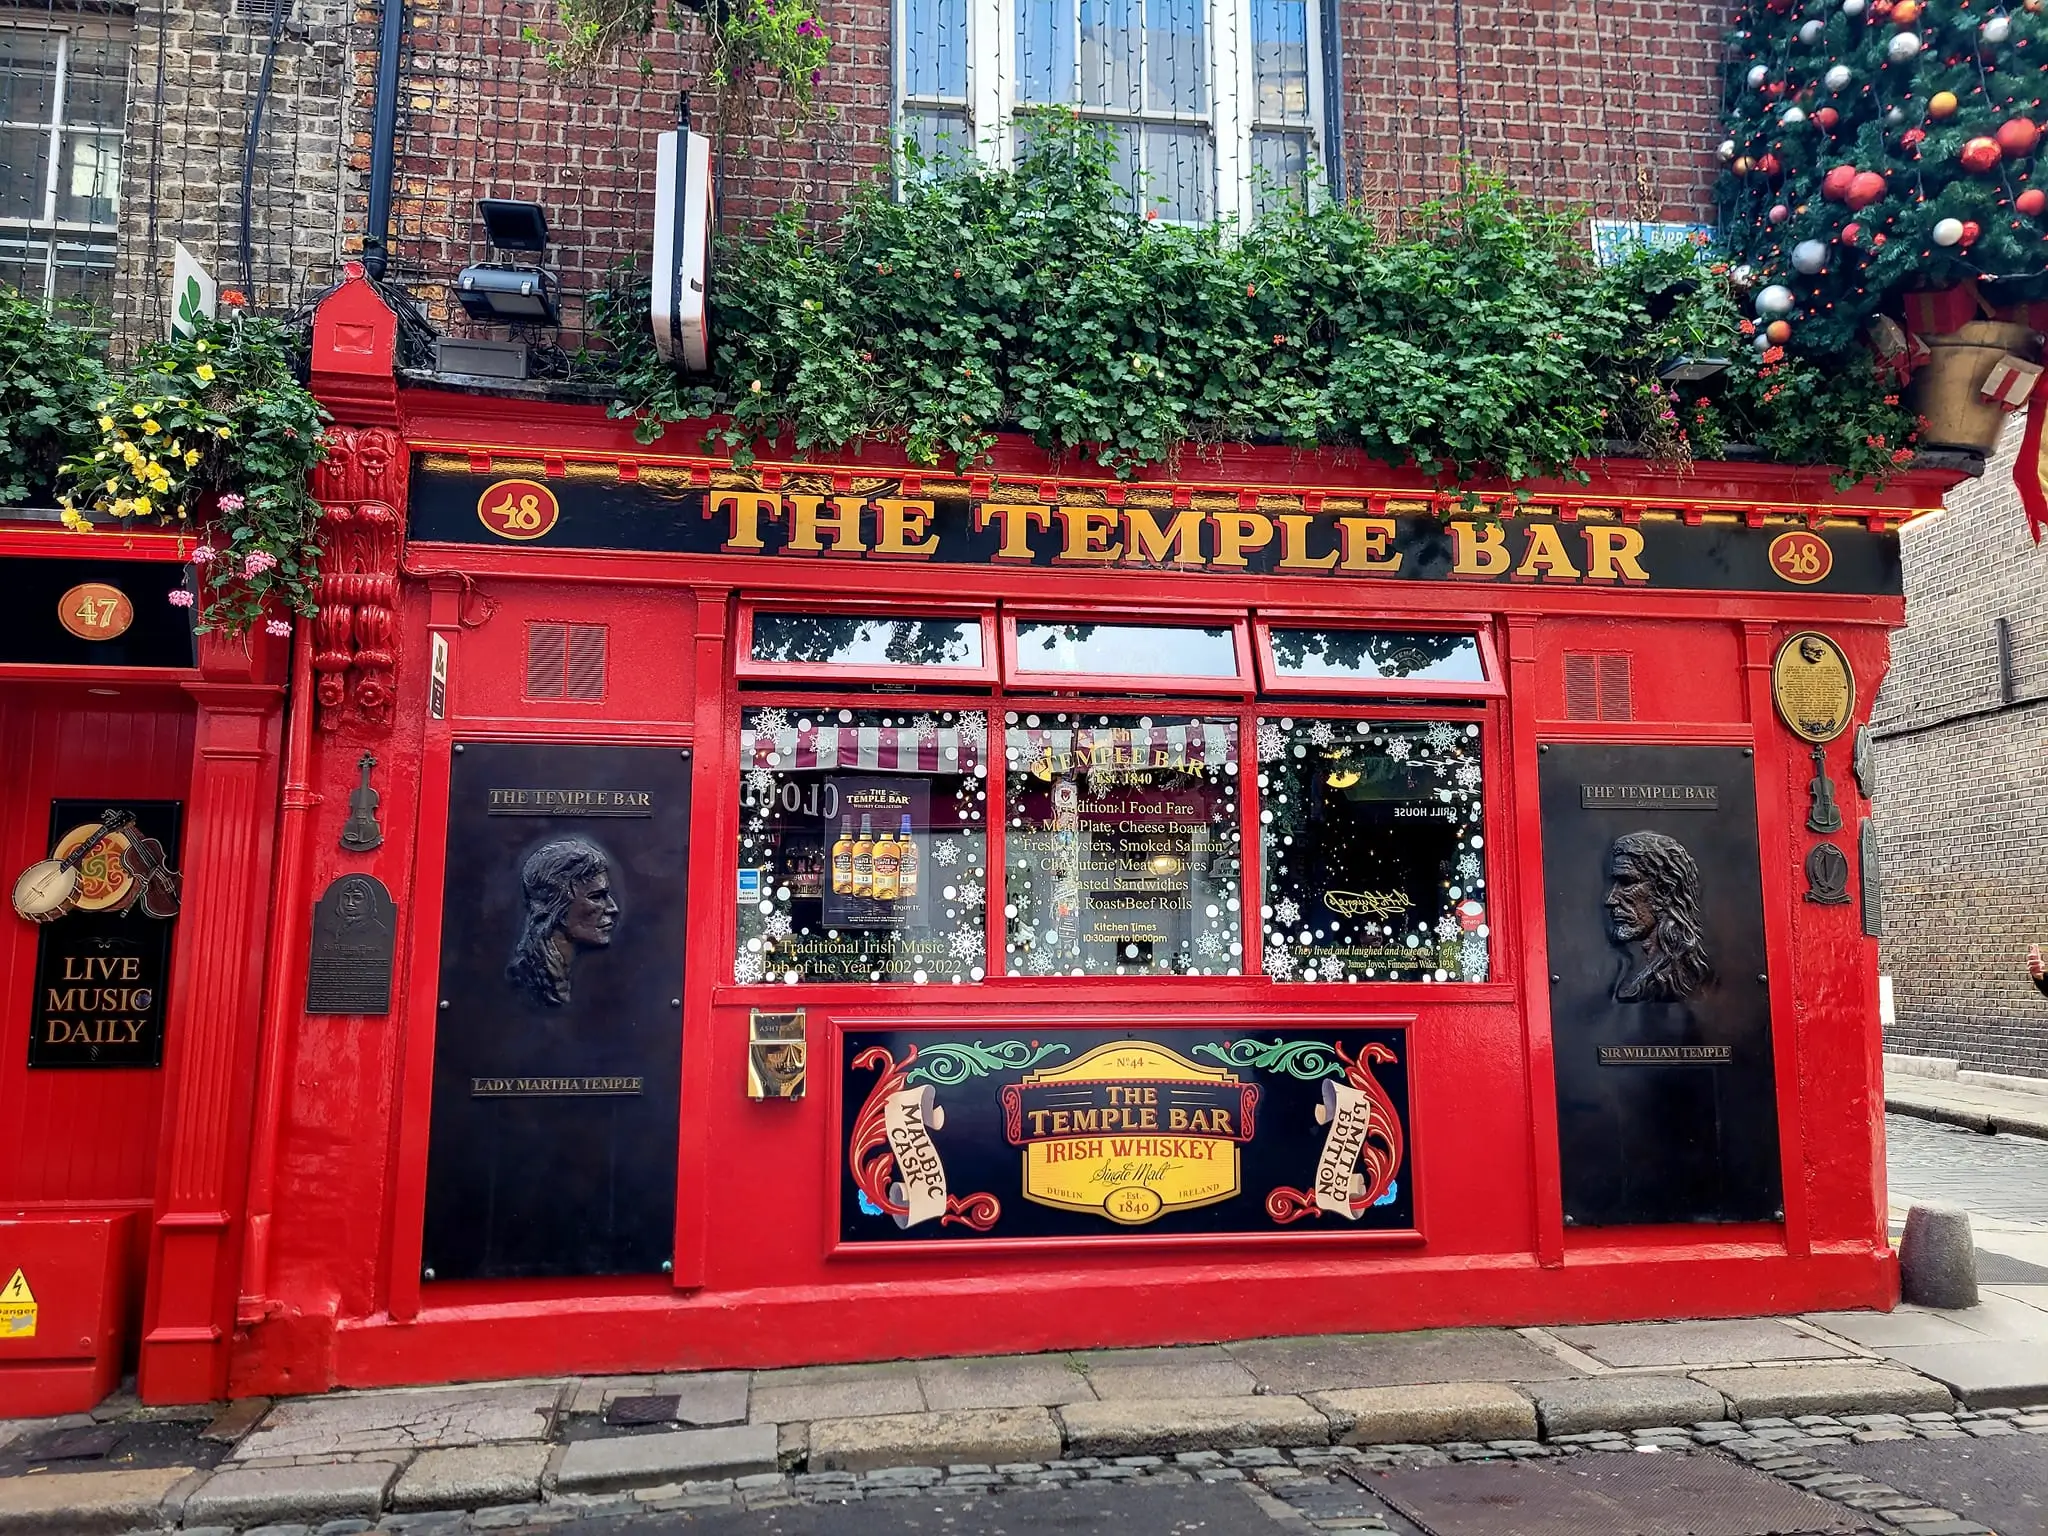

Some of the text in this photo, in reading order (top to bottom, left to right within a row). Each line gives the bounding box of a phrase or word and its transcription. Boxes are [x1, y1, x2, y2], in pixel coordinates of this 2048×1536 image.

[492, 493, 541, 530] 48
[704, 491, 1650, 582] THE TEMPLE BAR
[1779, 540, 1821, 574] 48
[75, 595, 118, 628] 47
[1044, 746, 1205, 779] TEMPLE BAR
[1095, 773, 1153, 785] Est. 1840
[490, 790, 651, 806] THE TEMPLE BAR
[1583, 785, 1717, 799] THE TEMPLE BAR
[846, 795, 911, 805] TEMPLE BAR
[1130, 801, 1162, 814] Food
[1166, 802, 1194, 815] Fare
[1080, 819, 1116, 834] Plate,
[1119, 820, 1165, 833] Cheese
[1168, 821, 1208, 834] Board
[1119, 838, 1173, 852] Smoked
[1175, 839, 1224, 852] Salmon
[1113, 877, 1189, 891] Sandwiches
[1085, 898, 1193, 910] Roast Beef Rolls
[1094, 922, 1157, 932] Kitchen Times
[780, 939, 945, 954] Traditional Irish Music
[1120, 934, 1131, 943] to
[1132, 934, 1168, 945] 10:00pm
[1314, 945, 1334, 956] lived
[1336, 946, 1350, 956] and
[1351, 945, 1383, 957] laughed
[1384, 945, 1399, 956] and
[63, 957, 141, 981] LIVE
[762, 960, 790, 974] Pub
[792, 959, 812, 974] of
[814, 960, 836, 974] the
[841, 960, 874, 974] Year
[878, 960, 912, 974] 2002
[927, 960, 962, 974] 2022
[1348, 960, 1367, 970] James
[1368, 960, 1387, 971] Joyce,
[46, 988, 153, 1012] MUSIC
[45, 1020, 148, 1043] DAILY
[1600, 1047, 1730, 1058] SIR WILLIAM TEMPLE
[473, 1077, 641, 1091] LADY MARTHA TEMPLE
[1106, 1086, 1159, 1106] THE
[1027, 1108, 1234, 1137] TEMPLE BAR
[891, 1127, 924, 1189] CASK
[901, 1103, 944, 1200] MALBEC
[1046, 1139, 1218, 1163] IRISH WHISKEY
[1318, 1108, 1352, 1197] EDITION
[1332, 1101, 1368, 1202] LIMITED
[1090, 1159, 1184, 1186] Single Malt
[1046, 1186, 1084, 1199] DUBLIN
[1125, 1191, 1143, 1200] Est.
[1178, 1183, 1220, 1199] IRELAND
[1118, 1201, 1149, 1214] 1840
